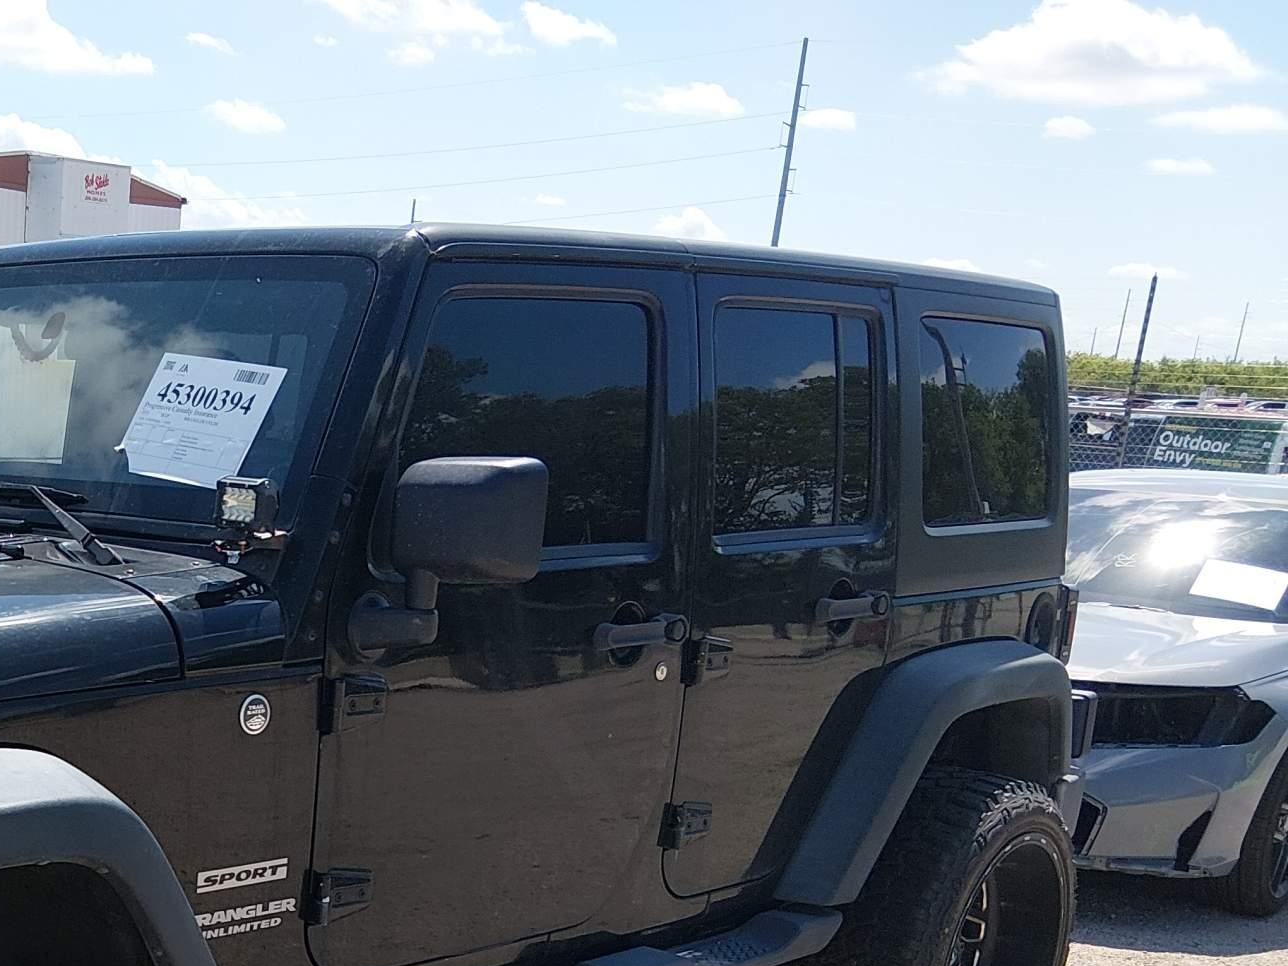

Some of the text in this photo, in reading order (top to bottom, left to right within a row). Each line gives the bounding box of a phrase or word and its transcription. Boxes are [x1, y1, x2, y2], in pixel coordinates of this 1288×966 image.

[157, 381, 257, 416] 45300394
[1159, 430, 1231, 454] Outdoor
[1154, 447, 1196, 467] Envy
[202, 864, 283, 887] SPORT
